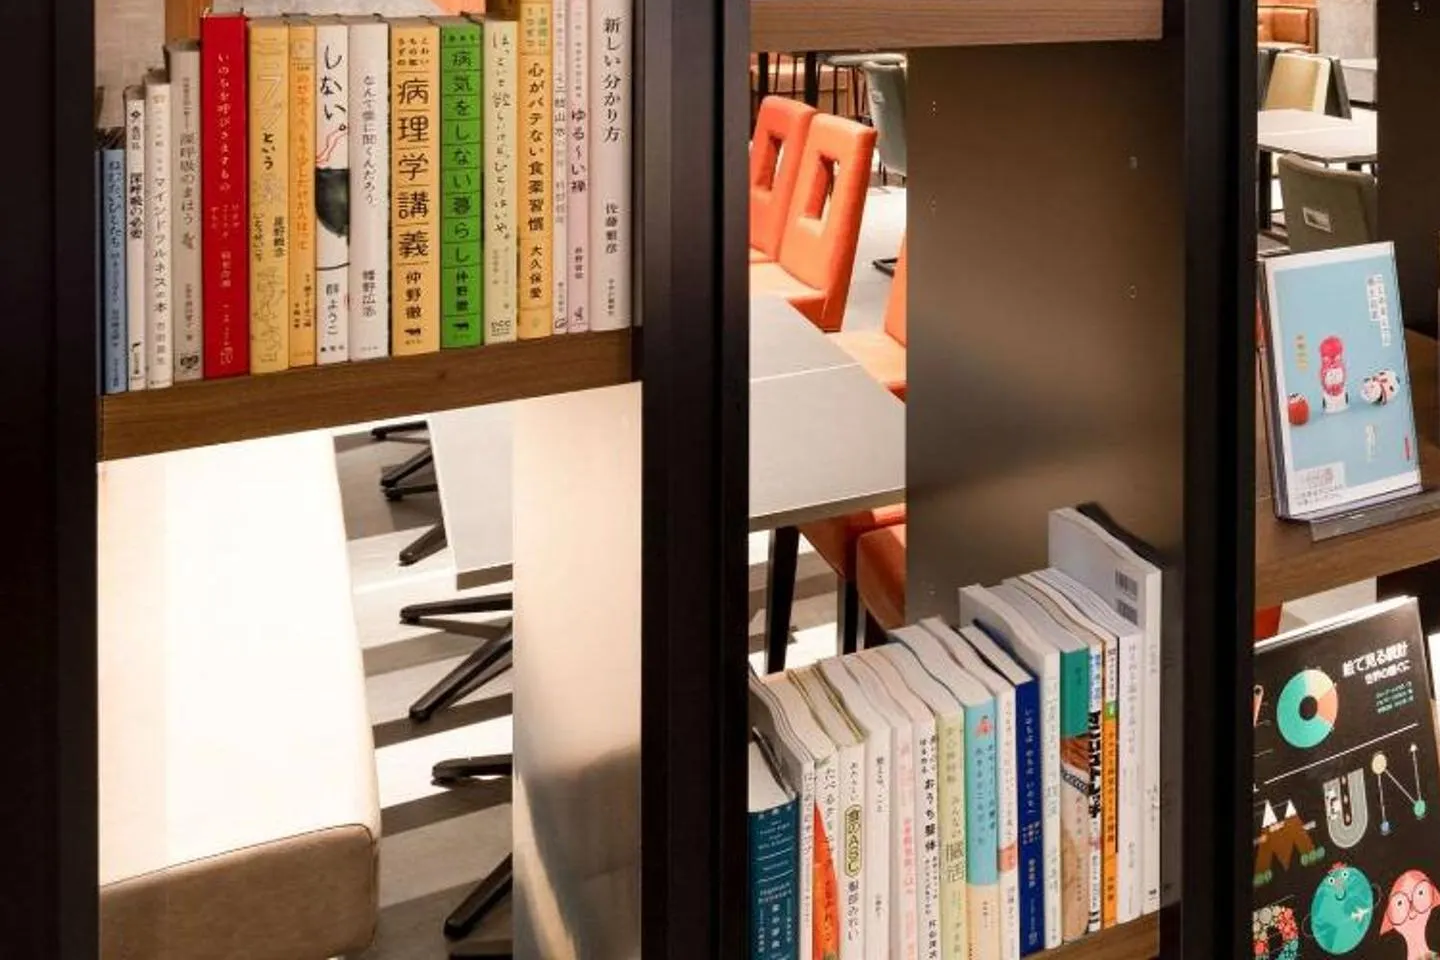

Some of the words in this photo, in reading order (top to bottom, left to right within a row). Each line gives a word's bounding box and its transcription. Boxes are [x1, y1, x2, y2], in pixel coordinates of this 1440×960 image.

[396, 78, 430, 259] 病理学講義
[452, 49, 473, 264] 病気をしない暮らし
[602, 16, 622, 143] 新しい分かり方
